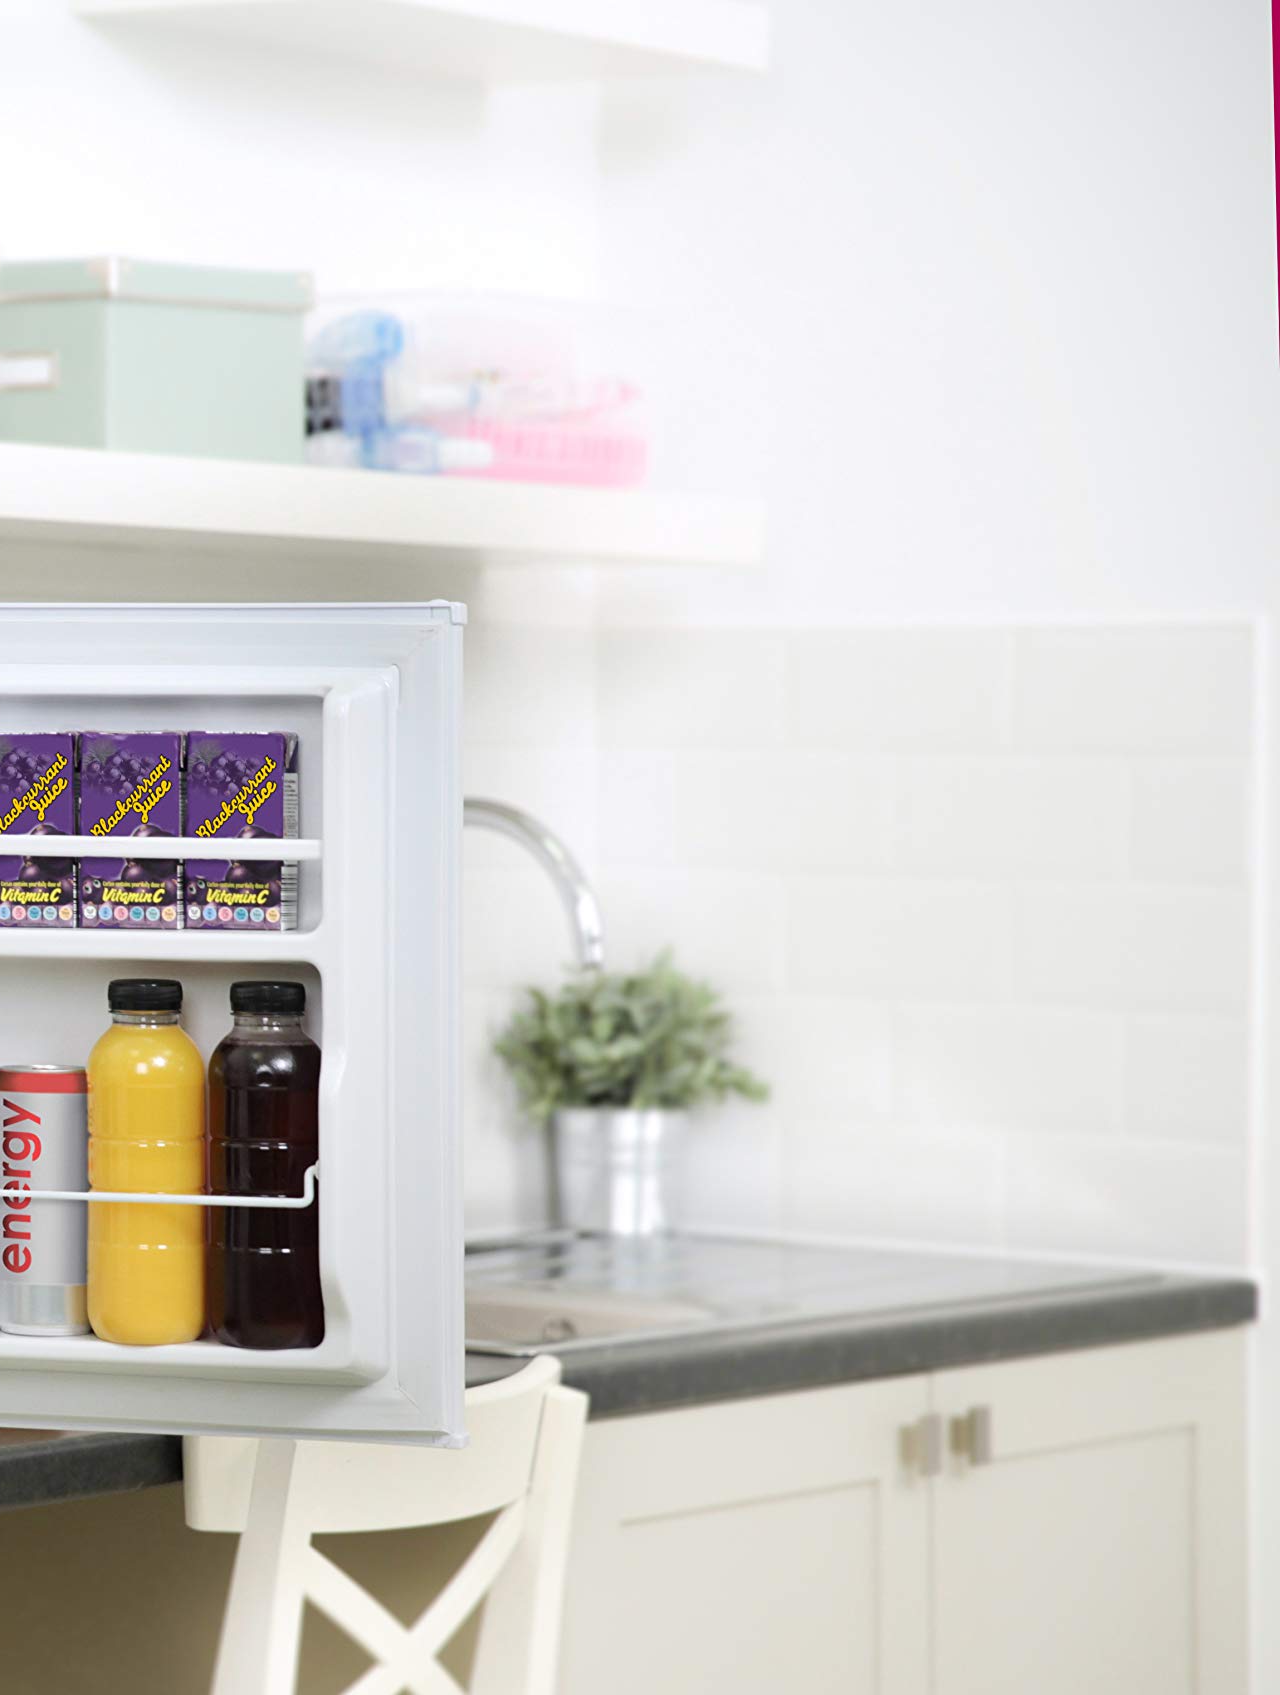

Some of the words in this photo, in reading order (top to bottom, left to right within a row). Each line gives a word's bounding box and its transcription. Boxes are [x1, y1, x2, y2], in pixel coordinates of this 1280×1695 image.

[29, 777, 68, 821] Juice
[89, 754, 171, 836] Blackcurrant
[132, 780, 171, 824] Juice
[195, 755, 276, 837] Blackcurrant
[238, 781, 277, 825] Juice
[0, 887, 49, 904] Vitamin
[49, 887, 62, 902] C
[102, 887, 152, 905] Vitamin
[152, 888, 166, 903] C
[206, 888, 256, 905] Vitamin
[256, 889, 269, 904] C
[2, 1098, 41, 1273] energy
